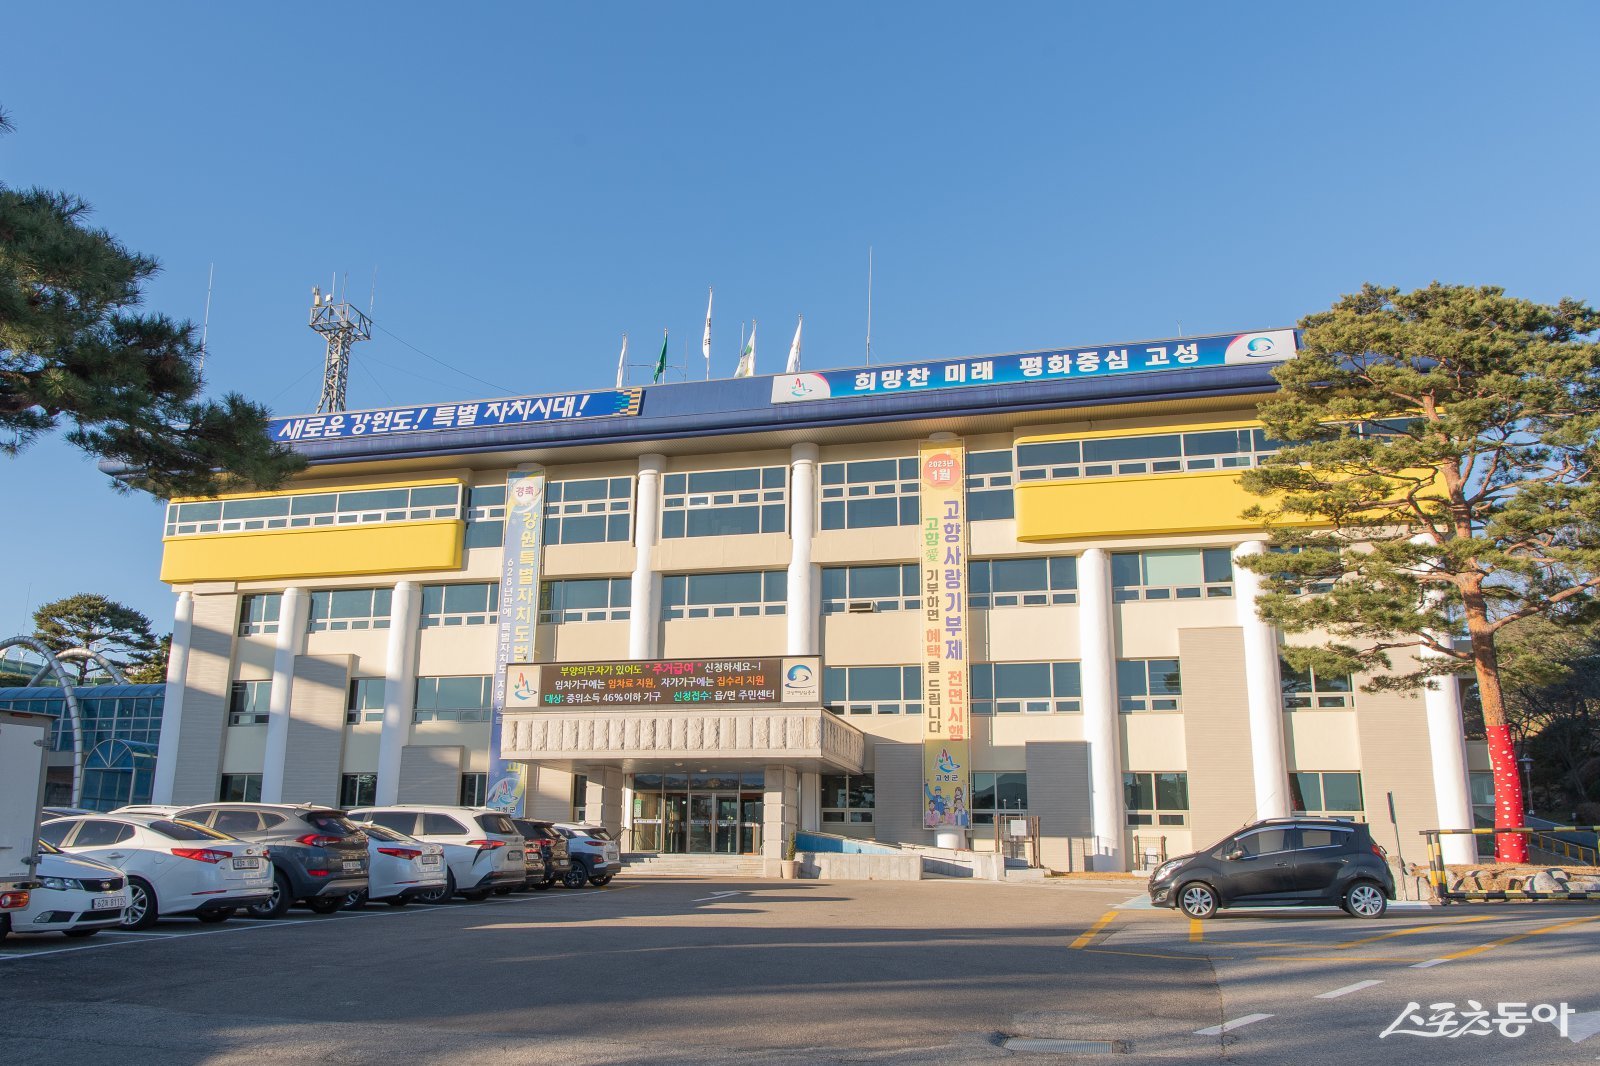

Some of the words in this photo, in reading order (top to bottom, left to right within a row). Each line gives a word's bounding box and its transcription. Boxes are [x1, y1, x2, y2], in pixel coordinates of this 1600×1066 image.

[854, 367, 930, 391] 희망찬
[944, 360, 993, 382] 미래
[1019, 349, 1129, 377] 평화중심
[1145, 343, 1199, 366] 고성
[278, 415, 345, 440] 새로운
[350, 408, 429, 435] 강원도!
[432, 404, 479, 427] 특별
[484, 395, 590, 423] 자치시대!
[928, 459, 954, 468] 2023년
[932, 468, 951, 481] 1월
[515, 486, 534, 497] 경축
[926, 568, 940, 622] 기부하면
[943, 500, 963, 661] 고향사랑기부제
[926, 628, 941, 674] 혜택을
[555, 679, 606, 691] 임차가구에는
[608, 678, 634, 689] 임차료
[636, 677, 656, 689] 지원,
[661, 676, 714, 688] 자가가구에는
[716, 675, 744, 687] 집수리
[746, 674, 765, 686] 지원
[560, 665, 613, 677] 부양의무자가
[544, 693, 565, 704] 대상:
[566, 692, 601, 704] 중위소득
[643, 691, 662, 702] 가구
[673, 691, 712, 702] 신청접수:
[714, 690, 736, 702] 읍/면
[738, 689, 775, 700] 주민센터
[928, 679, 942, 734] 드립니다
[946, 670, 964, 742] 전면시행
[935, 774, 959, 782] 고성군
